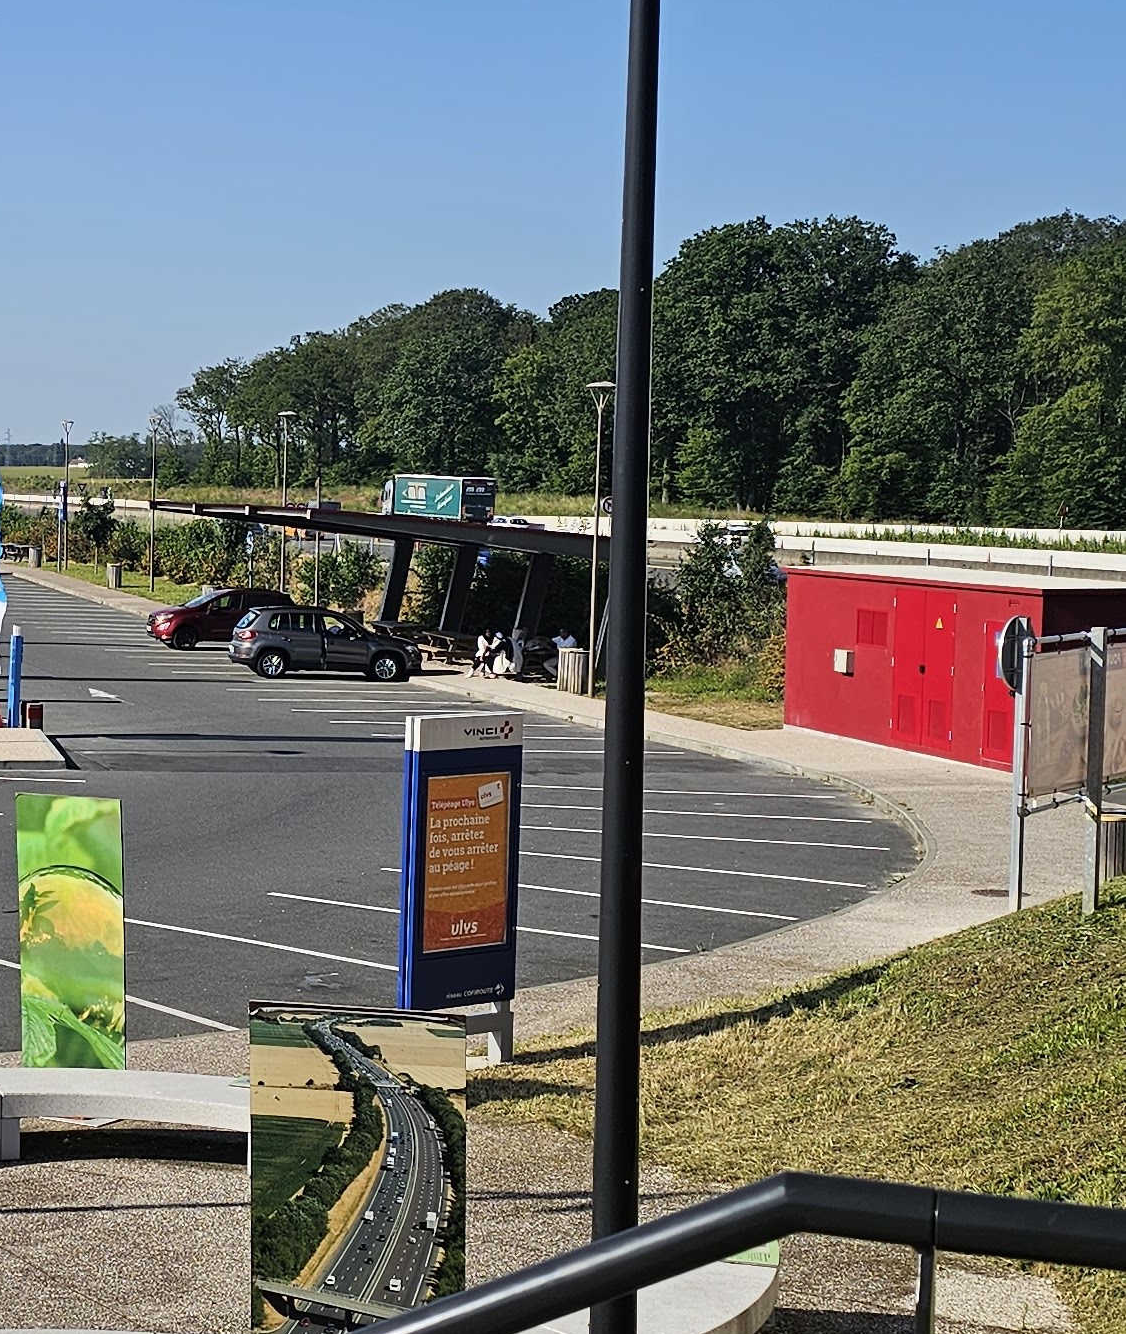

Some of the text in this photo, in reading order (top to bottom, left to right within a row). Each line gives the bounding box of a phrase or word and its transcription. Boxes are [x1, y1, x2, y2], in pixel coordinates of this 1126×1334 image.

[464, 727, 497, 736] VINCI
[430, 814, 490, 830] La prochaine
[429, 828, 485, 844] fois, arrêtez
[429, 842, 498, 858] de vous arrêter
[429, 863, 440, 873] au
[451, 919, 478, 935] ulys
